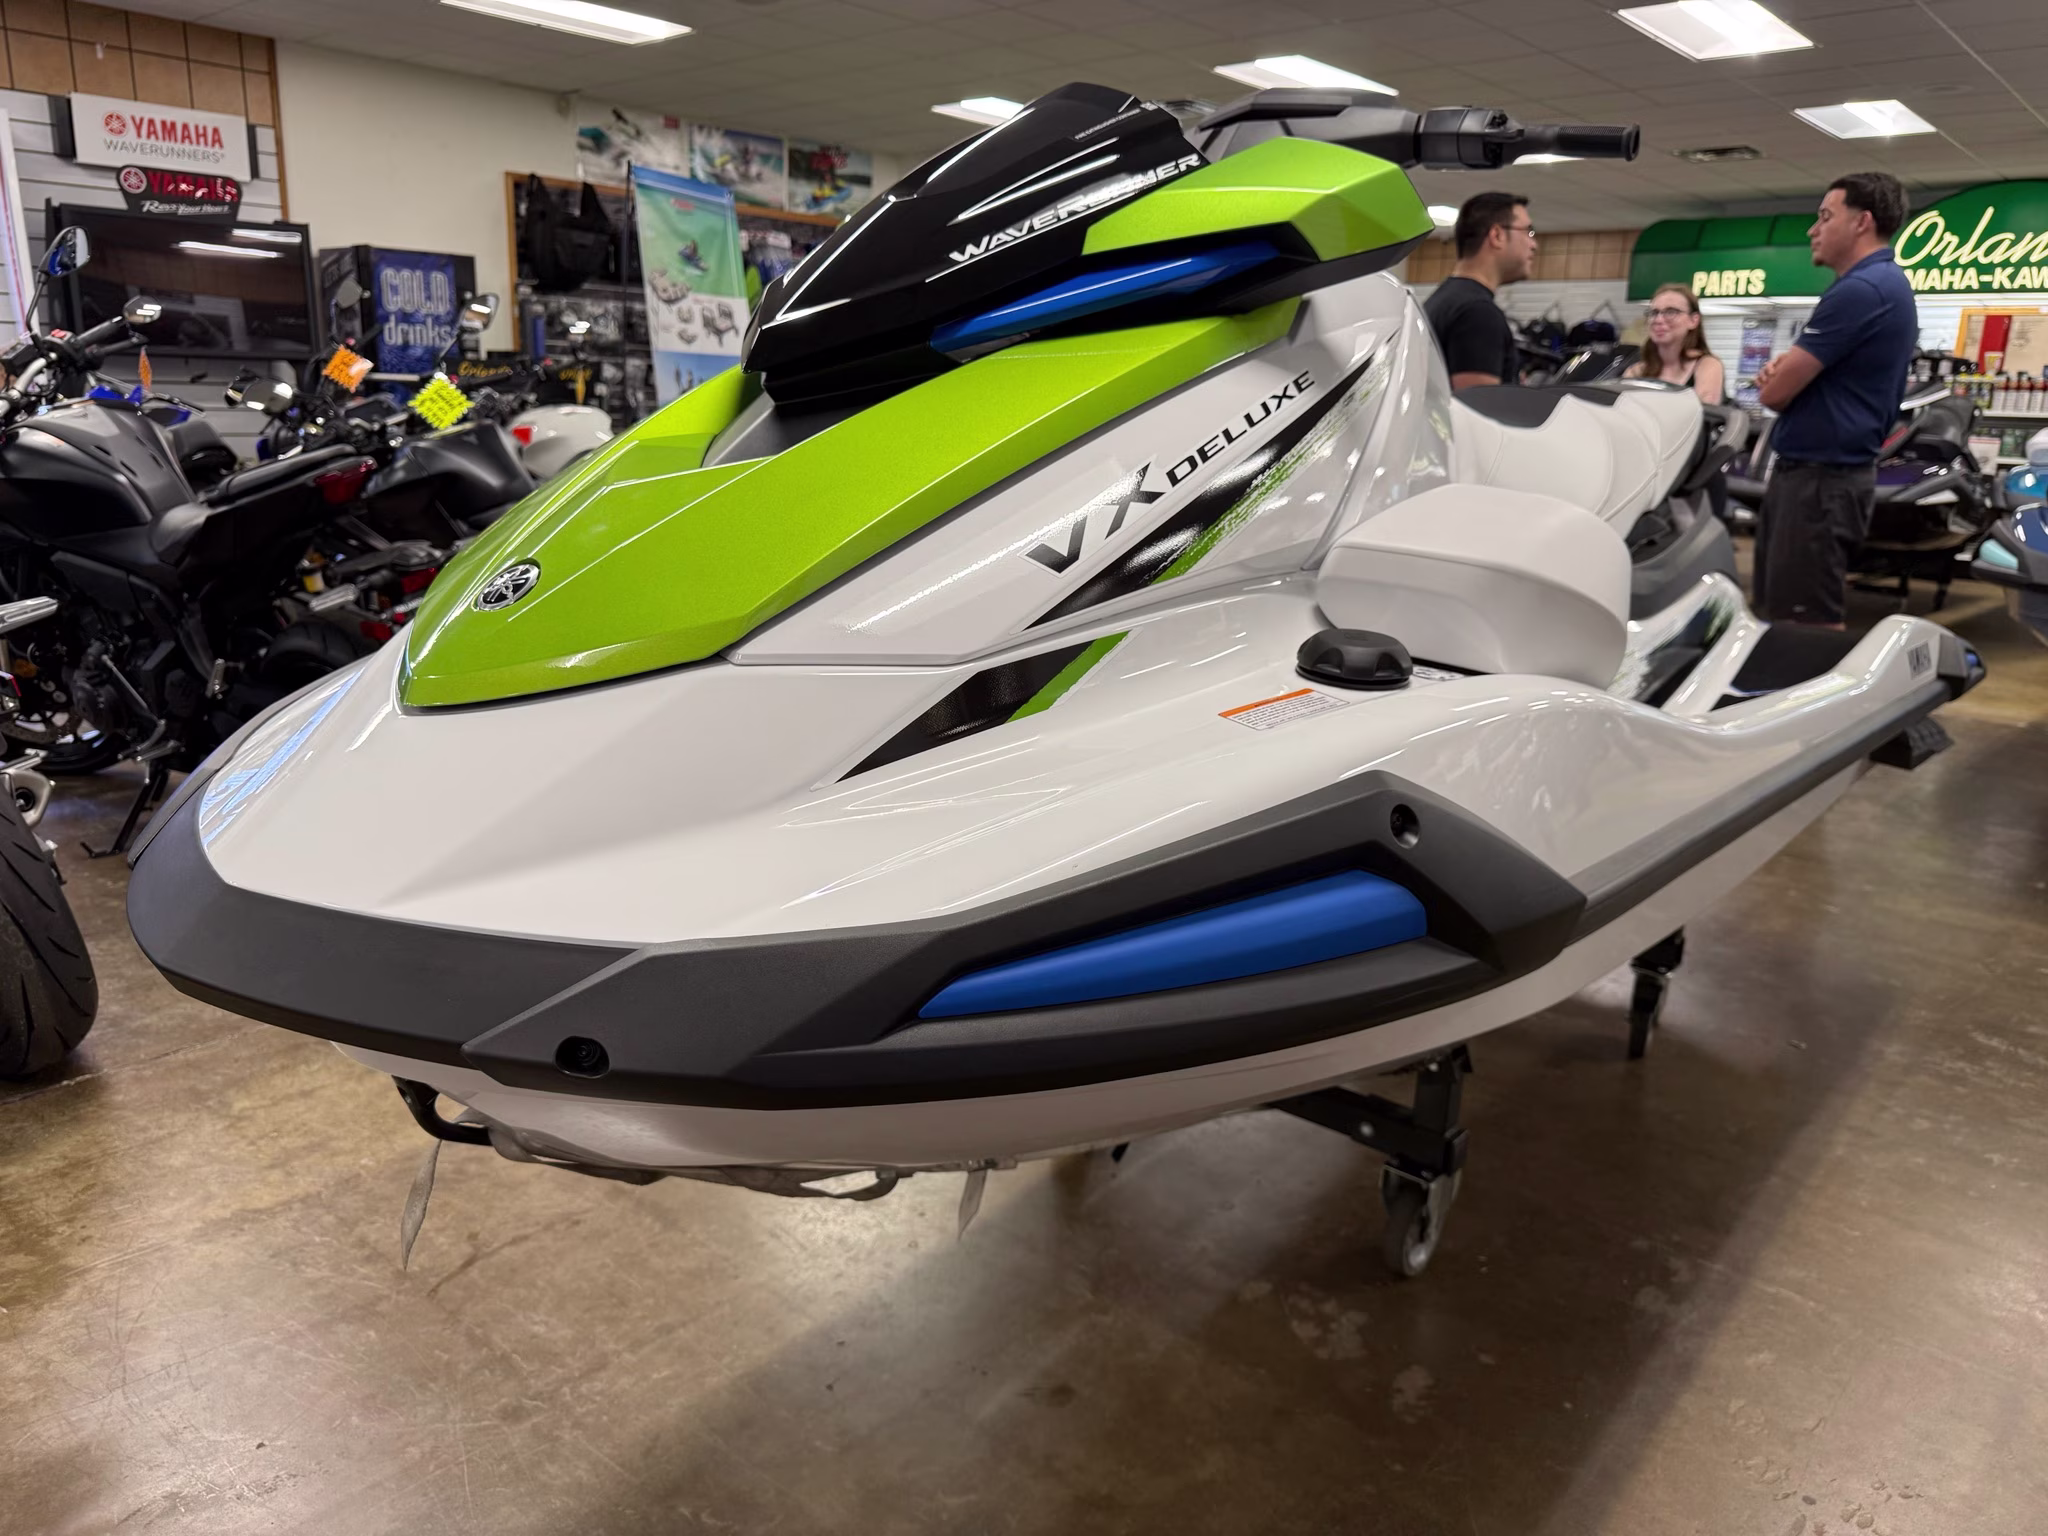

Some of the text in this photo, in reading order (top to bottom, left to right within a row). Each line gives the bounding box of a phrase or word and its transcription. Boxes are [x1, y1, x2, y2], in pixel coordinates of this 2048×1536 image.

[131, 114, 224, 149] YAMAHA
[103, 138, 221, 164] WAVERUNNERS
[146, 169, 239, 203] YAMAHA
[949, 152, 1201, 263] WAVERNER
[1894, 205, 2048, 267] Orlan
[380, 266, 450, 316] COLD
[1692, 268, 1766, 297] PARTS
[383, 314, 452, 347] drinks
[1025, 370, 1316, 574] VX DELUXE
